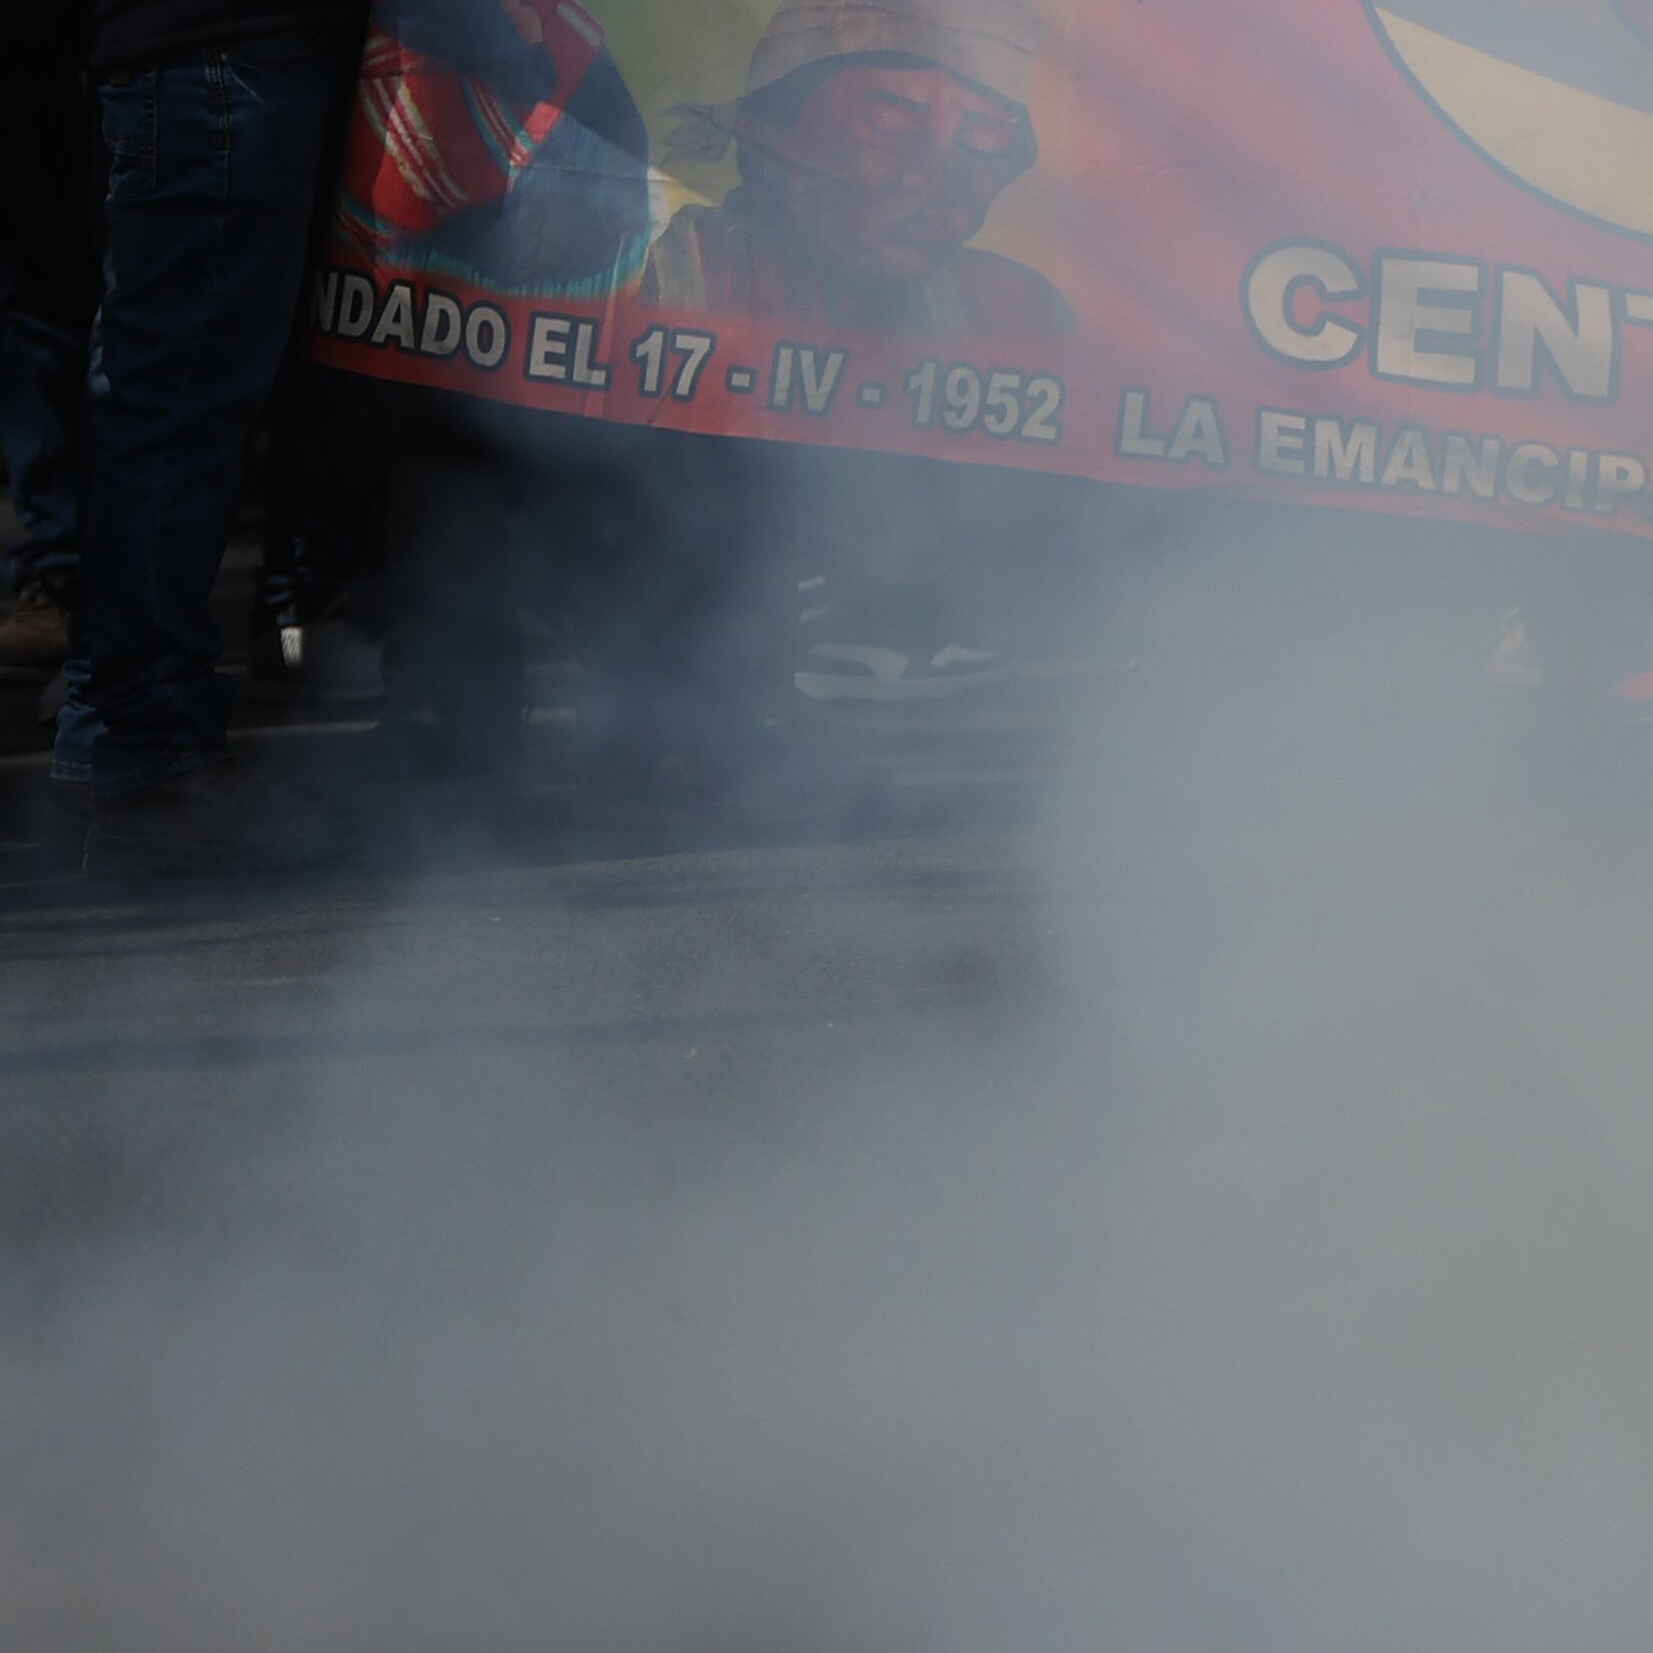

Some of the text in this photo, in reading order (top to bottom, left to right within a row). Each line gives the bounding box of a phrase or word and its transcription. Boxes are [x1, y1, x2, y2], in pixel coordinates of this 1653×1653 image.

[529, 317, 608, 388] EL
[635, 330, 715, 399] 17
[773, 346, 845, 412] IV
[909, 361, 1064, 441] 1952
[1118, 390, 1226, 464] LA
